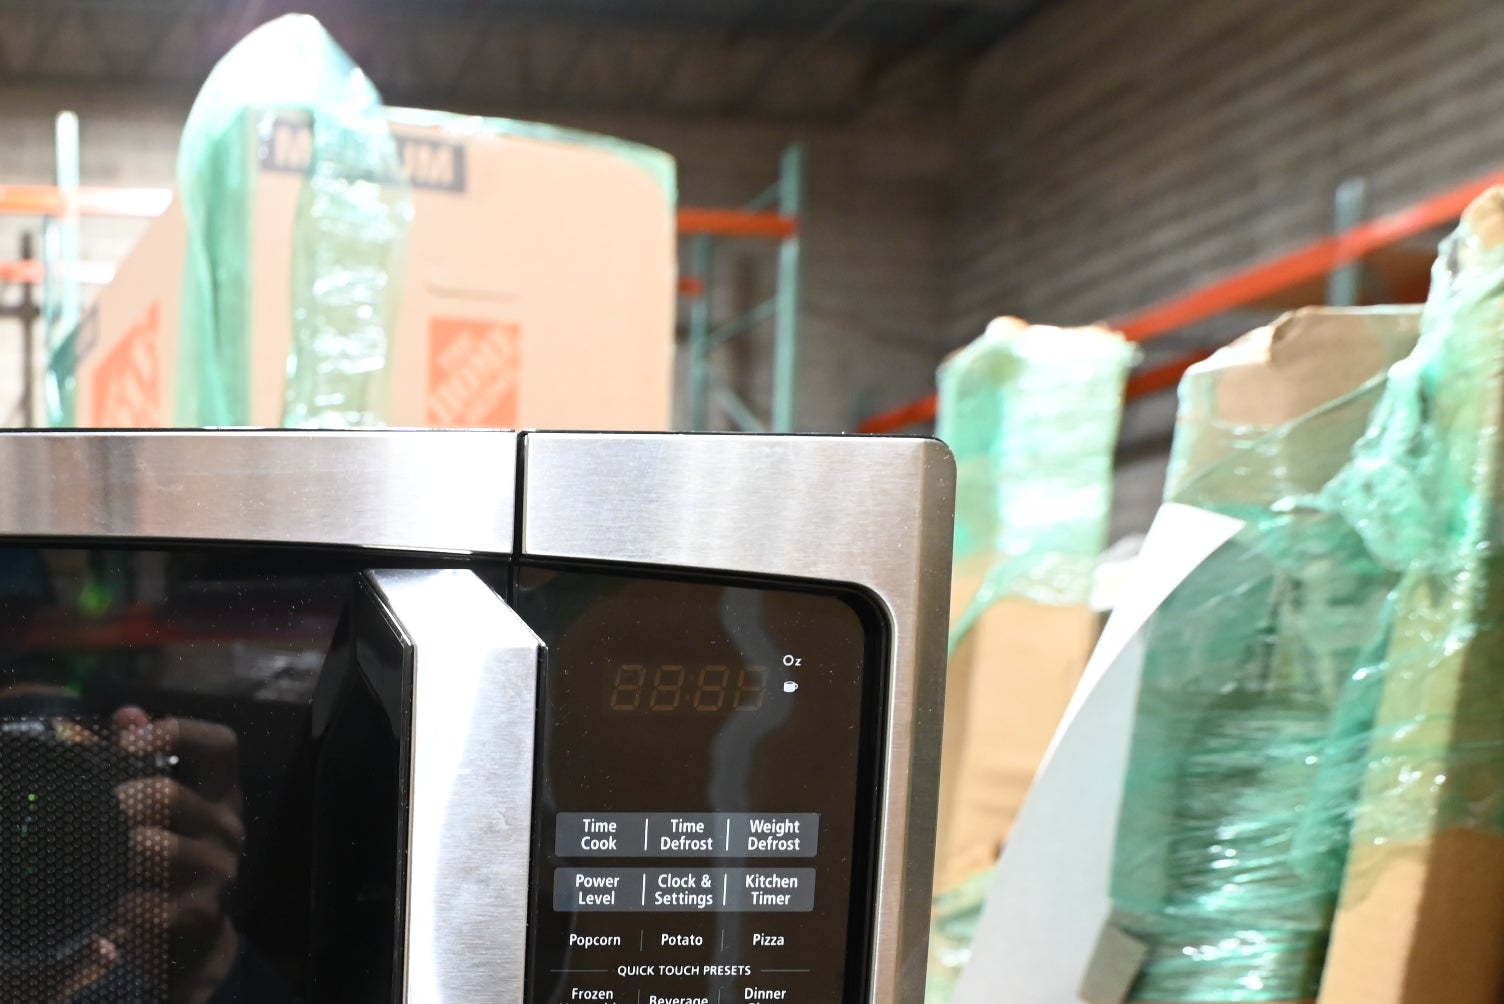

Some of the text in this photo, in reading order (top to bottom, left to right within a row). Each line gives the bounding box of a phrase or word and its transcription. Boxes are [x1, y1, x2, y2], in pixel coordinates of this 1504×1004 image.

[783, 655, 802, 667] Oz
[583, 819, 616, 832] Time
[671, 819, 704, 832] Time
[750, 819, 799, 837] Weight
[581, 836, 616, 849] Cook
[661, 836, 712, 850] Defrost
[748, 836, 800, 850] Defrost
[576, 874, 619, 887] Power
[658, 874, 711, 887] Clock &
[746, 874, 797, 887] Kitchen
[579, 891, 614, 904] Level
[655, 891, 712, 908] Settings
[751, 891, 790, 905] Timer
[570, 934, 620, 948] Popcorn
[662, 934, 702, 945] Potato
[753, 933, 784, 945] Pizza
[618, 966, 751, 976] QUICK TOUCH PRESETS
[572, 988, 613, 999] Frozen
[745, 987, 786, 999] Dinner
